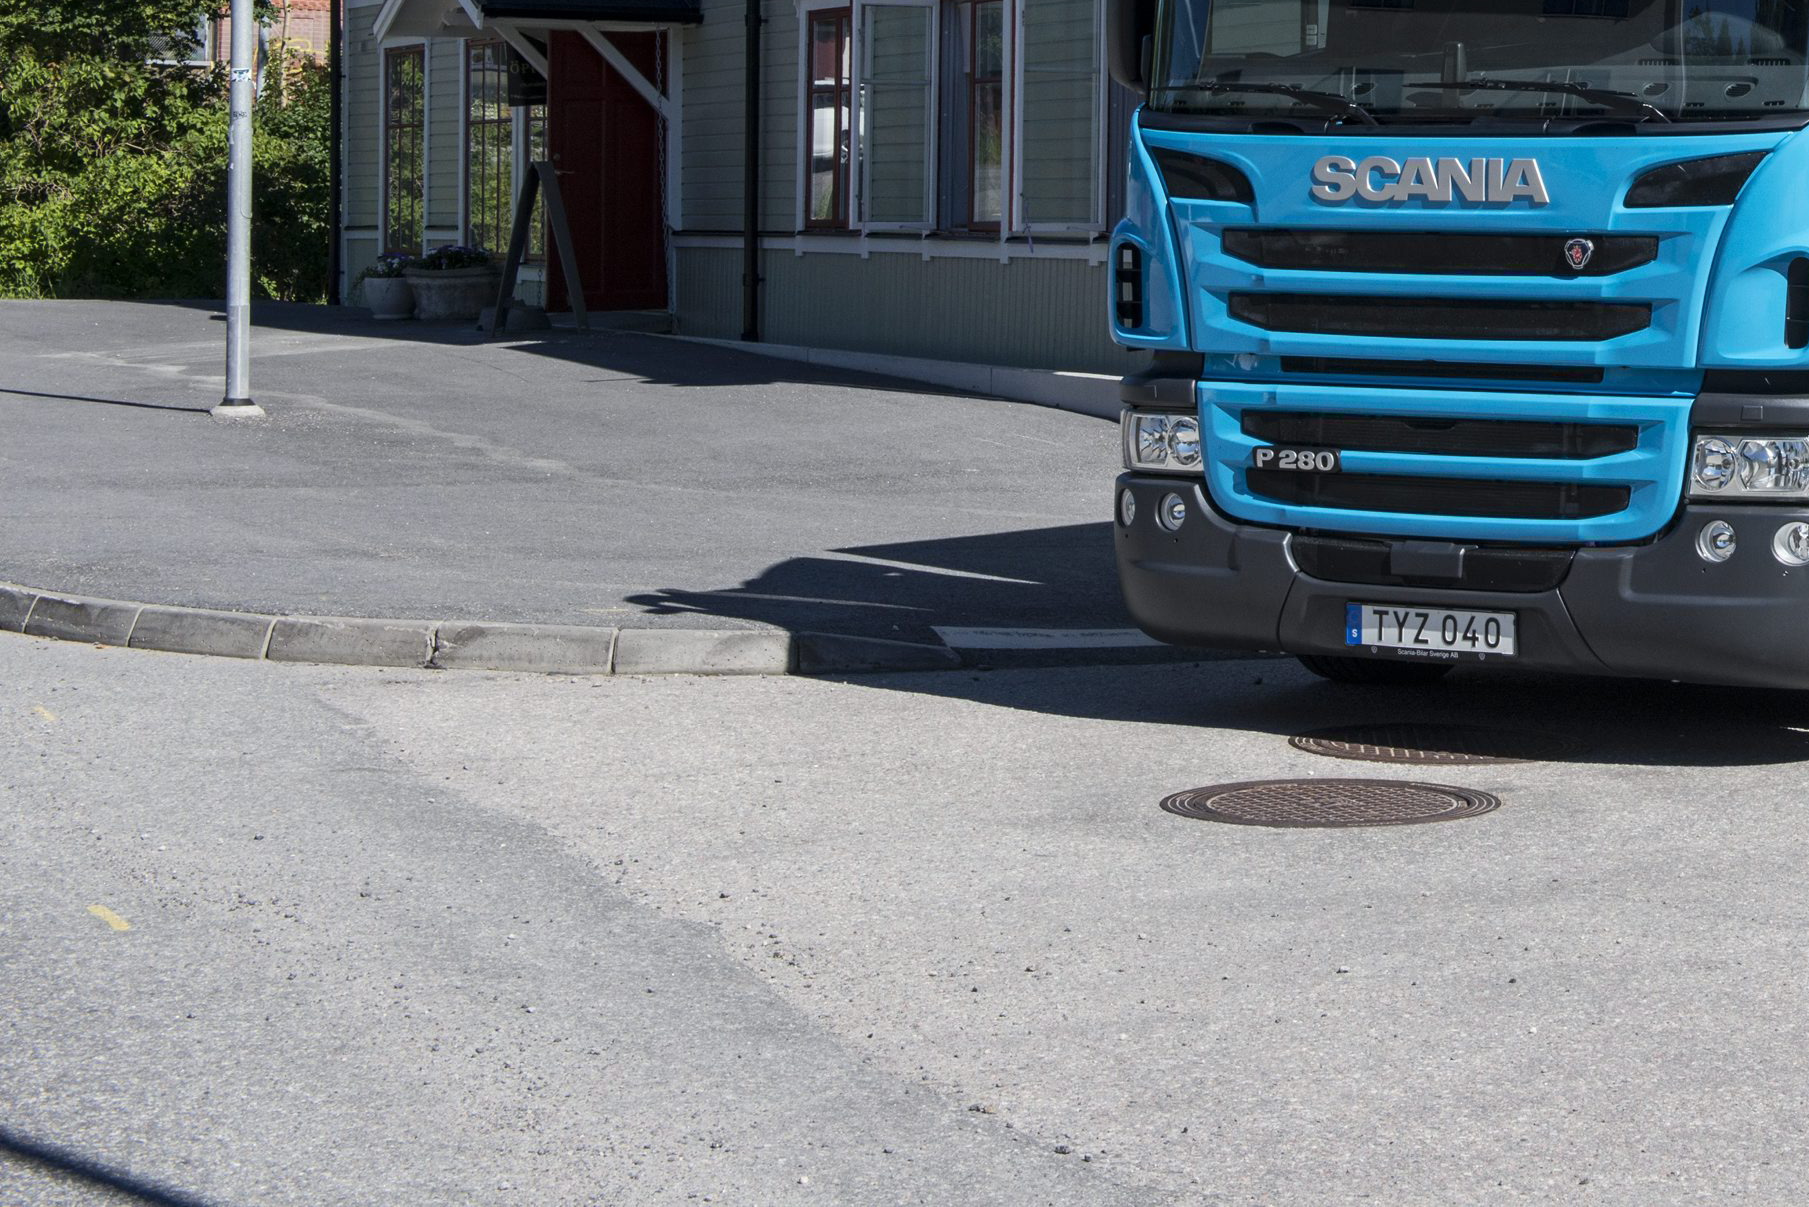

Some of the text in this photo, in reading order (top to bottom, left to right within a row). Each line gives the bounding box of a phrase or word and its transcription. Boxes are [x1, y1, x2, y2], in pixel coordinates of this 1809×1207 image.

[1311, 155, 1550, 204] SCANIA
[1256, 448, 1335, 471] P 280
[1351, 628, 1358, 638] S
[1372, 609, 1501, 649] TYZ 040
[1397, 648, 1459, 659] Scania-Bilar Sverige AB
